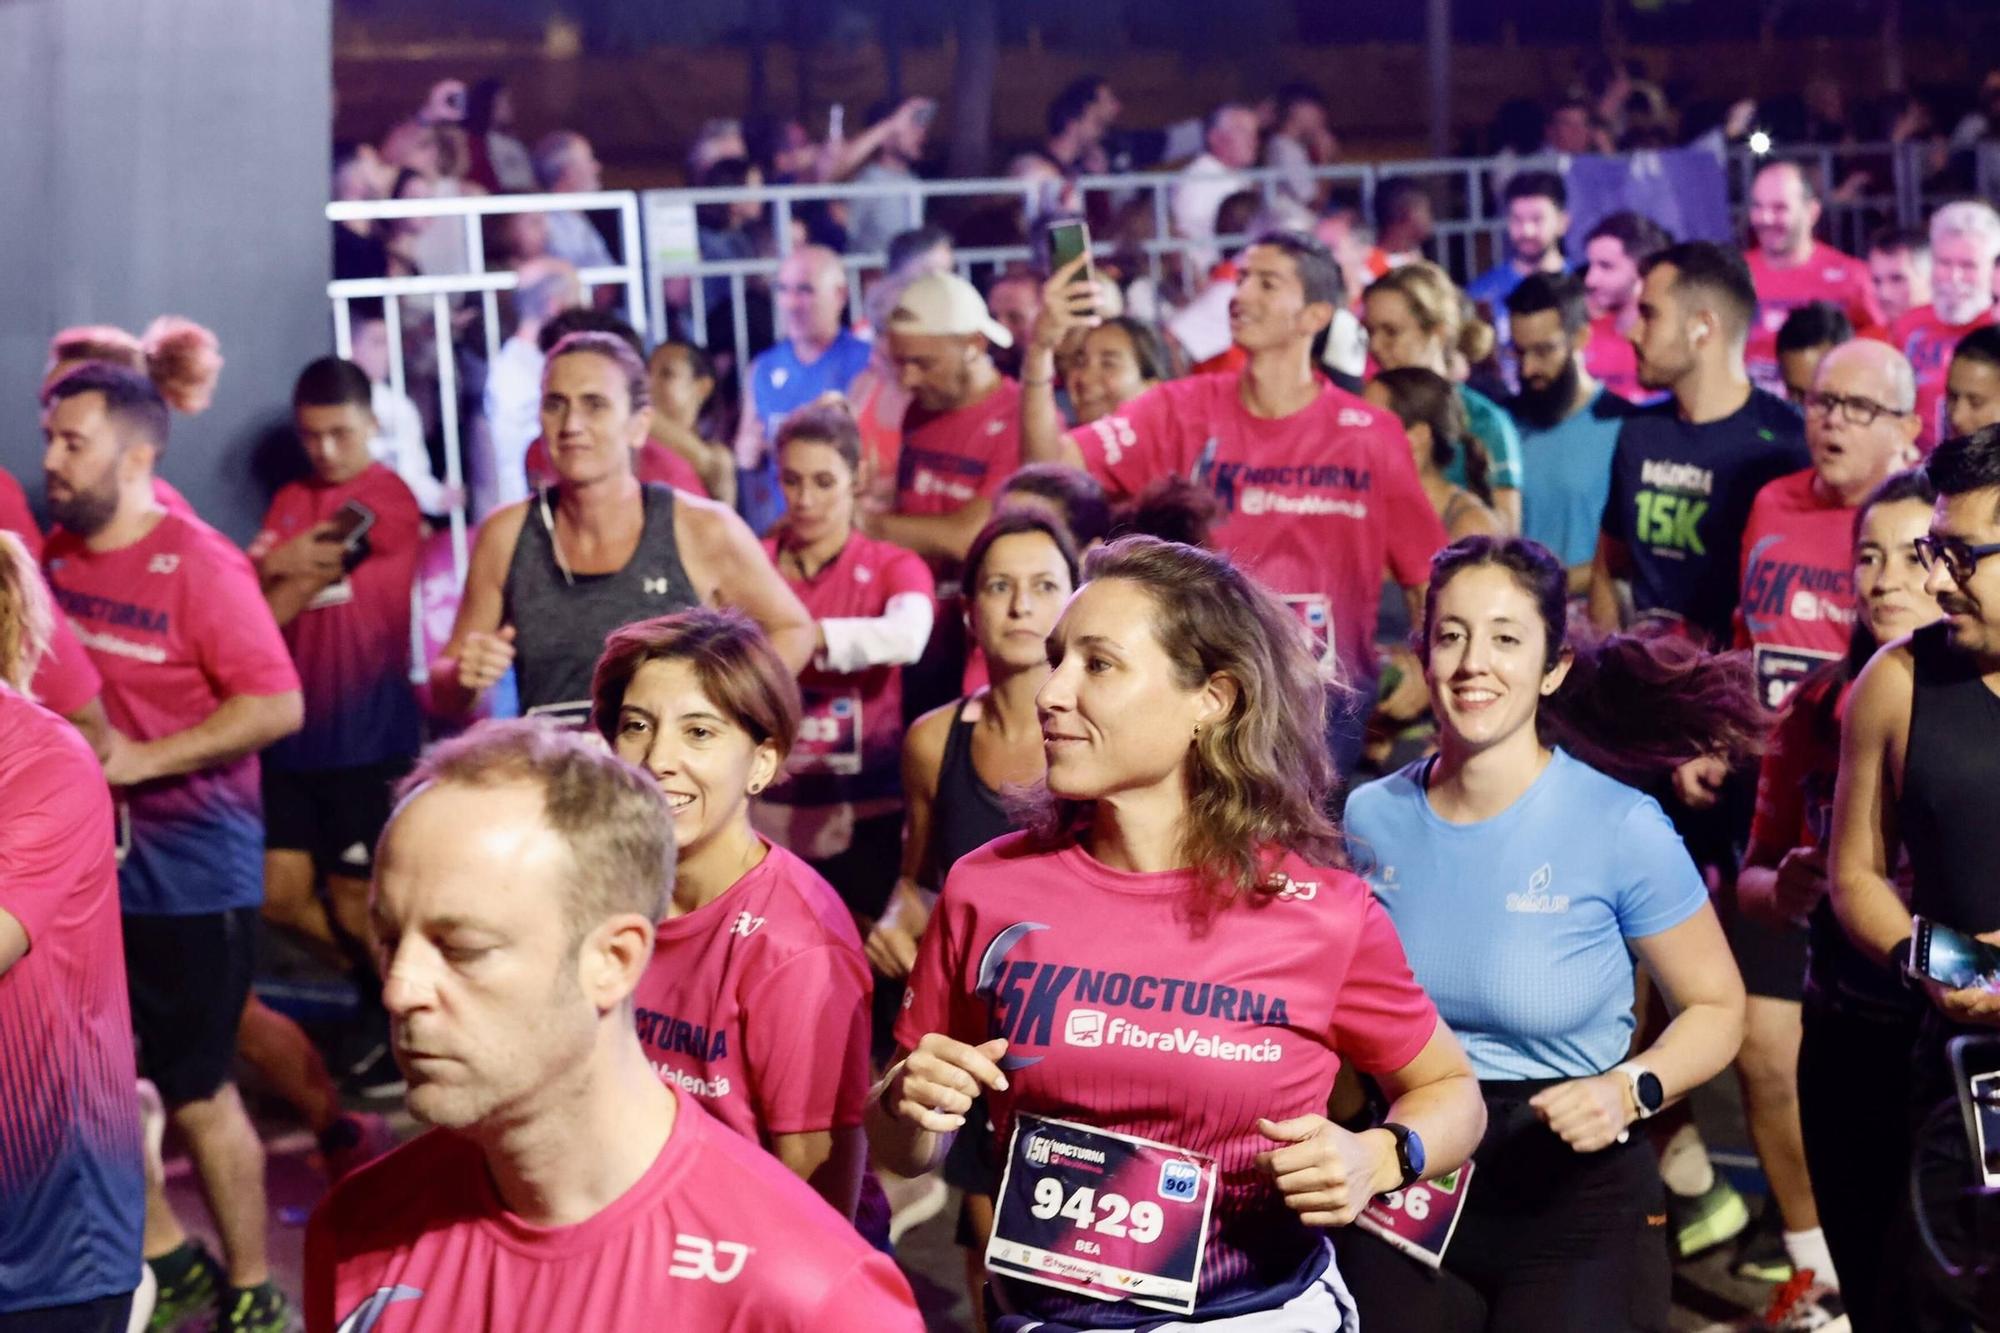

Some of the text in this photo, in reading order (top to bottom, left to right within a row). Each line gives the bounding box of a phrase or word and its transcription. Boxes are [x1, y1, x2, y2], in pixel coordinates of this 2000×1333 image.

[1635, 490, 1708, 556] 15K
[1074, 968, 1291, 1027] NOCTURNA
[634, 1007, 728, 1063] CTURNA
[1106, 1018, 1283, 1063] FibraValencia
[651, 1060, 731, 1098] Valencia
[1025, 1135, 1056, 1164] 15K
[1051, 1141, 1106, 1165] NOCTURNA
[1031, 1177, 1165, 1244] 9429
[1074, 1239, 1101, 1256] BEA
